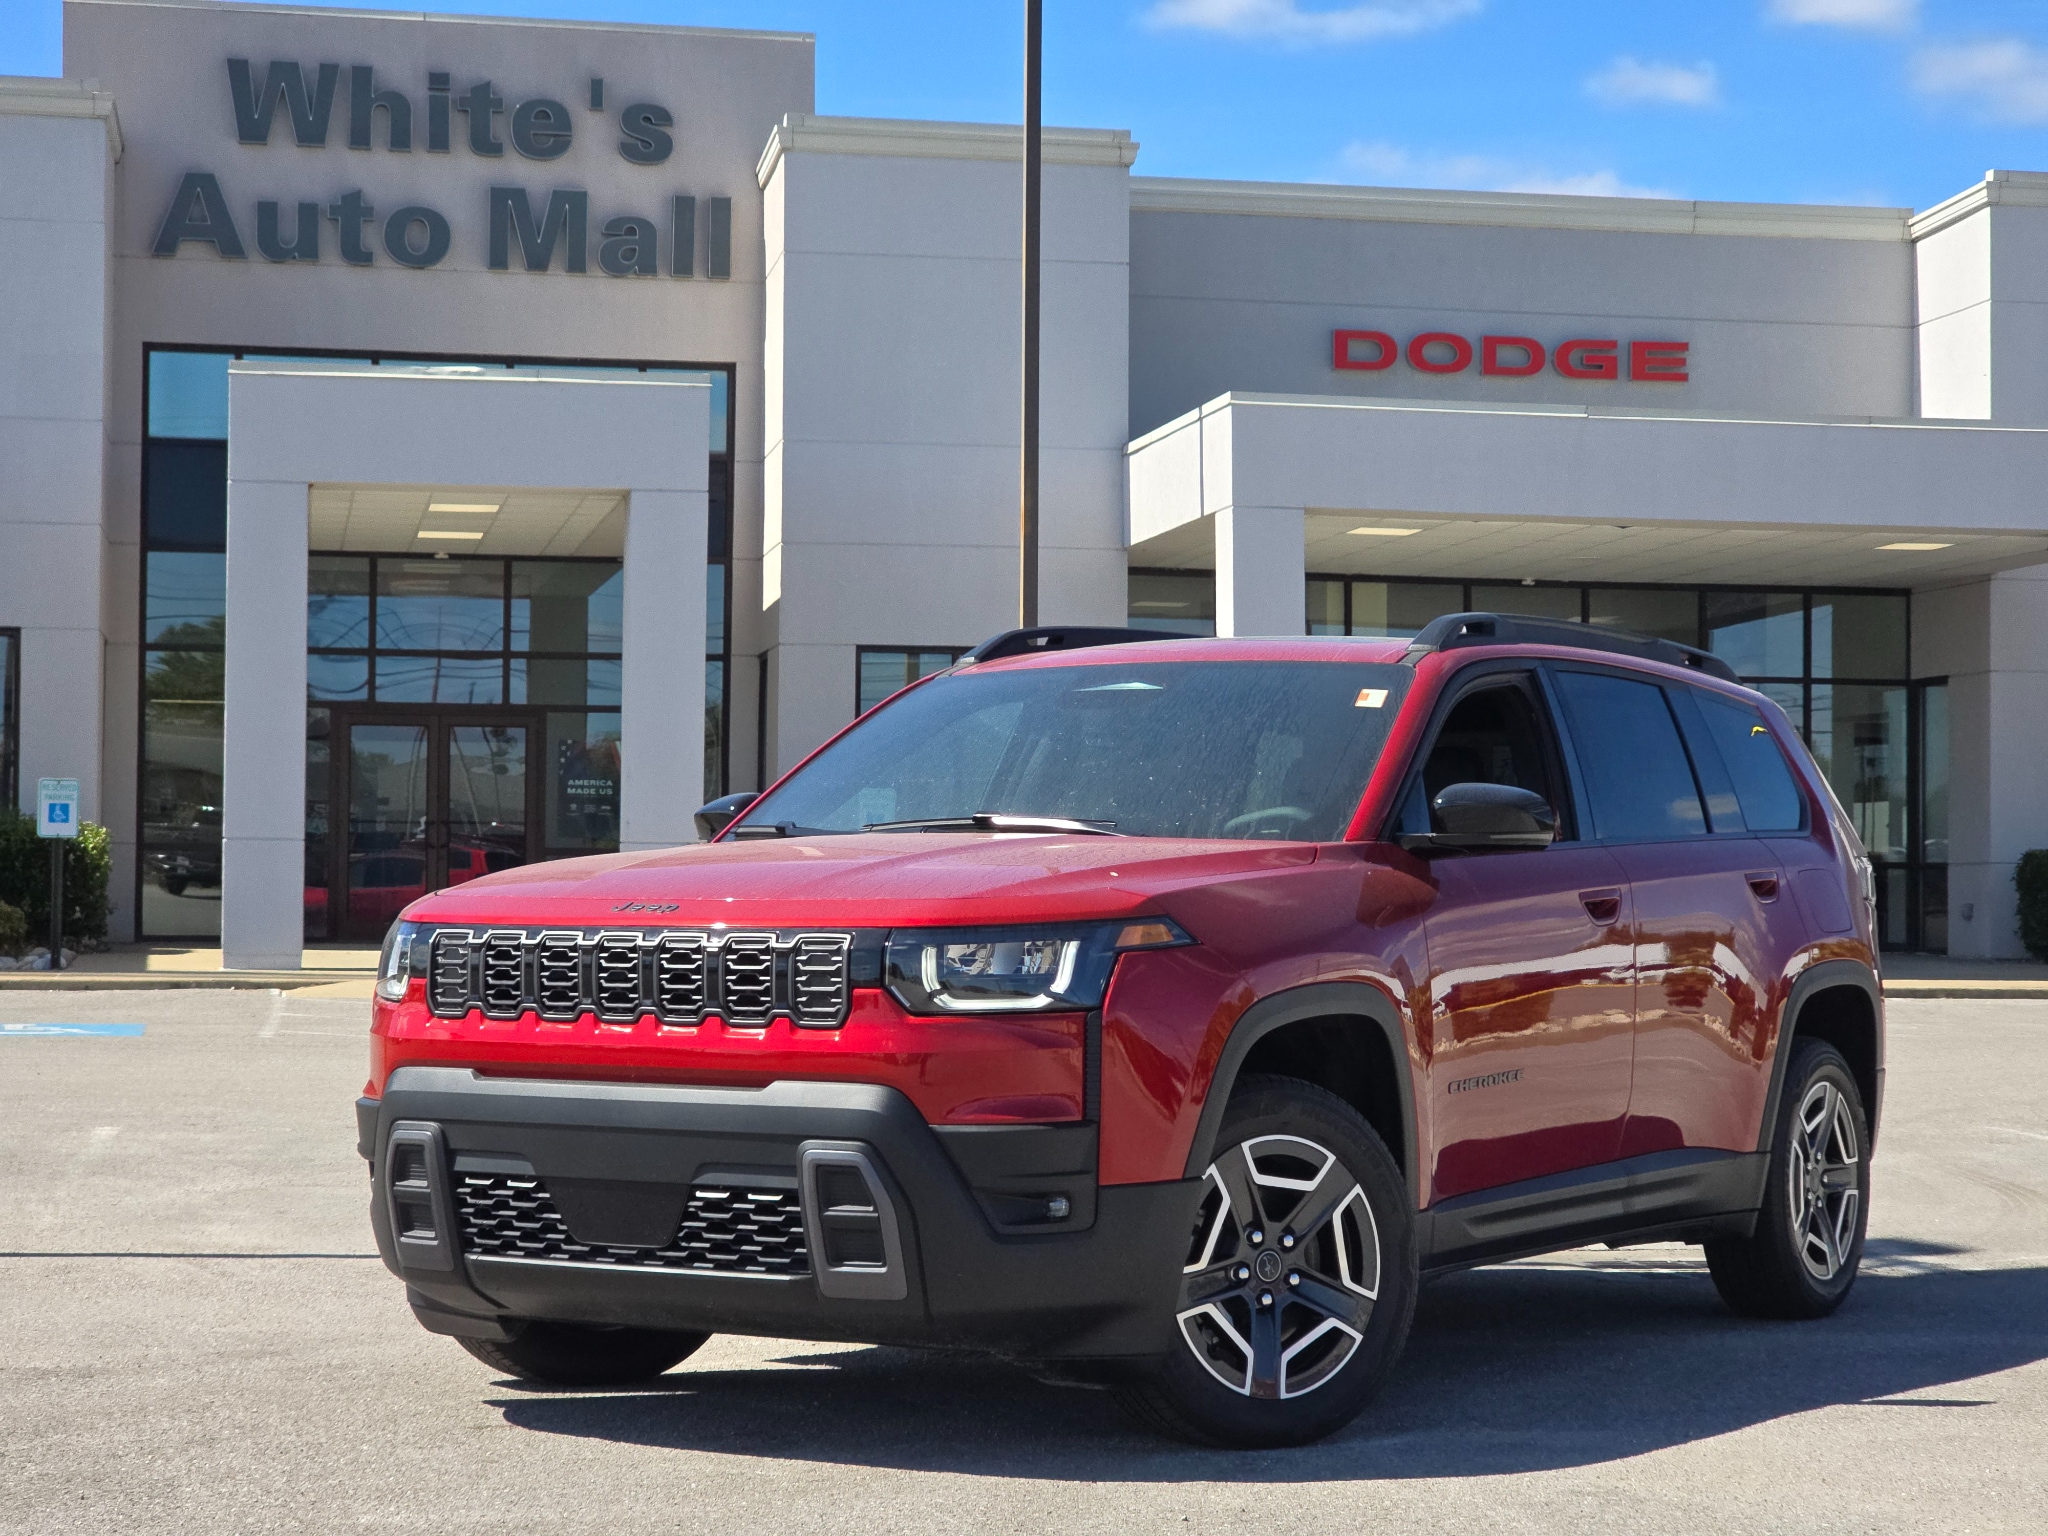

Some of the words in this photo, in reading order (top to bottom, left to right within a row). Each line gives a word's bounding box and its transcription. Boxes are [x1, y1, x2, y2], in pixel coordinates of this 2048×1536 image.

[226, 58, 674, 165] White's
[152, 172, 452, 269] Auto
[488, 186, 732, 280] Mall
[1332, 328, 1690, 382] DODGE
[611, 901, 680, 914] Jeep
[1447, 1067, 1525, 1095] CHEROKEE
